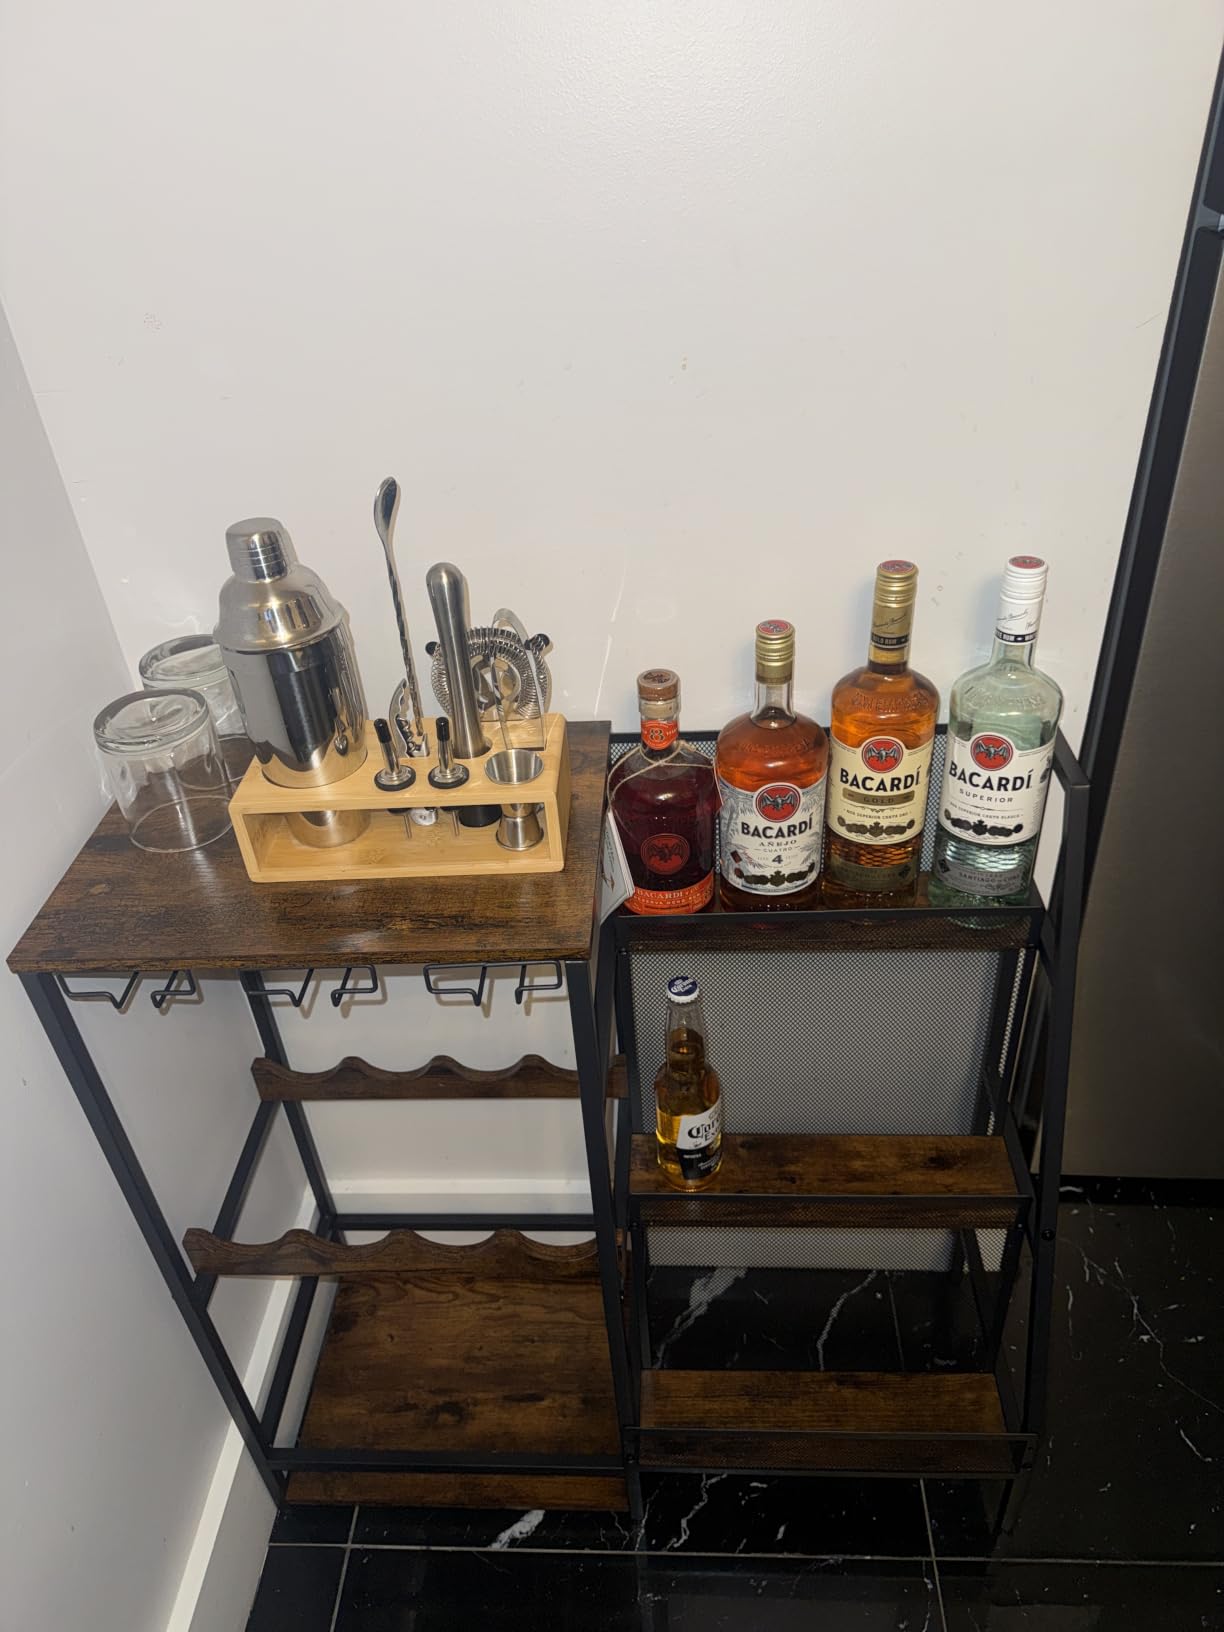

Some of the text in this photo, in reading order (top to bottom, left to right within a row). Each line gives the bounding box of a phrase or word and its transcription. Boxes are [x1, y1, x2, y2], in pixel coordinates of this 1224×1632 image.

[649, 728, 665, 741] 8
[840, 765, 921, 792] BACARDÍ
[949, 761, 1034, 791] BACARDÍ
[863, 796, 895, 804] GOLD
[959, 788, 1014, 803] SUPERIOR
[741, 812, 813, 838] BACARDÍ
[759, 839, 798, 847] AÑEJO
[771, 854, 784, 865] 4
